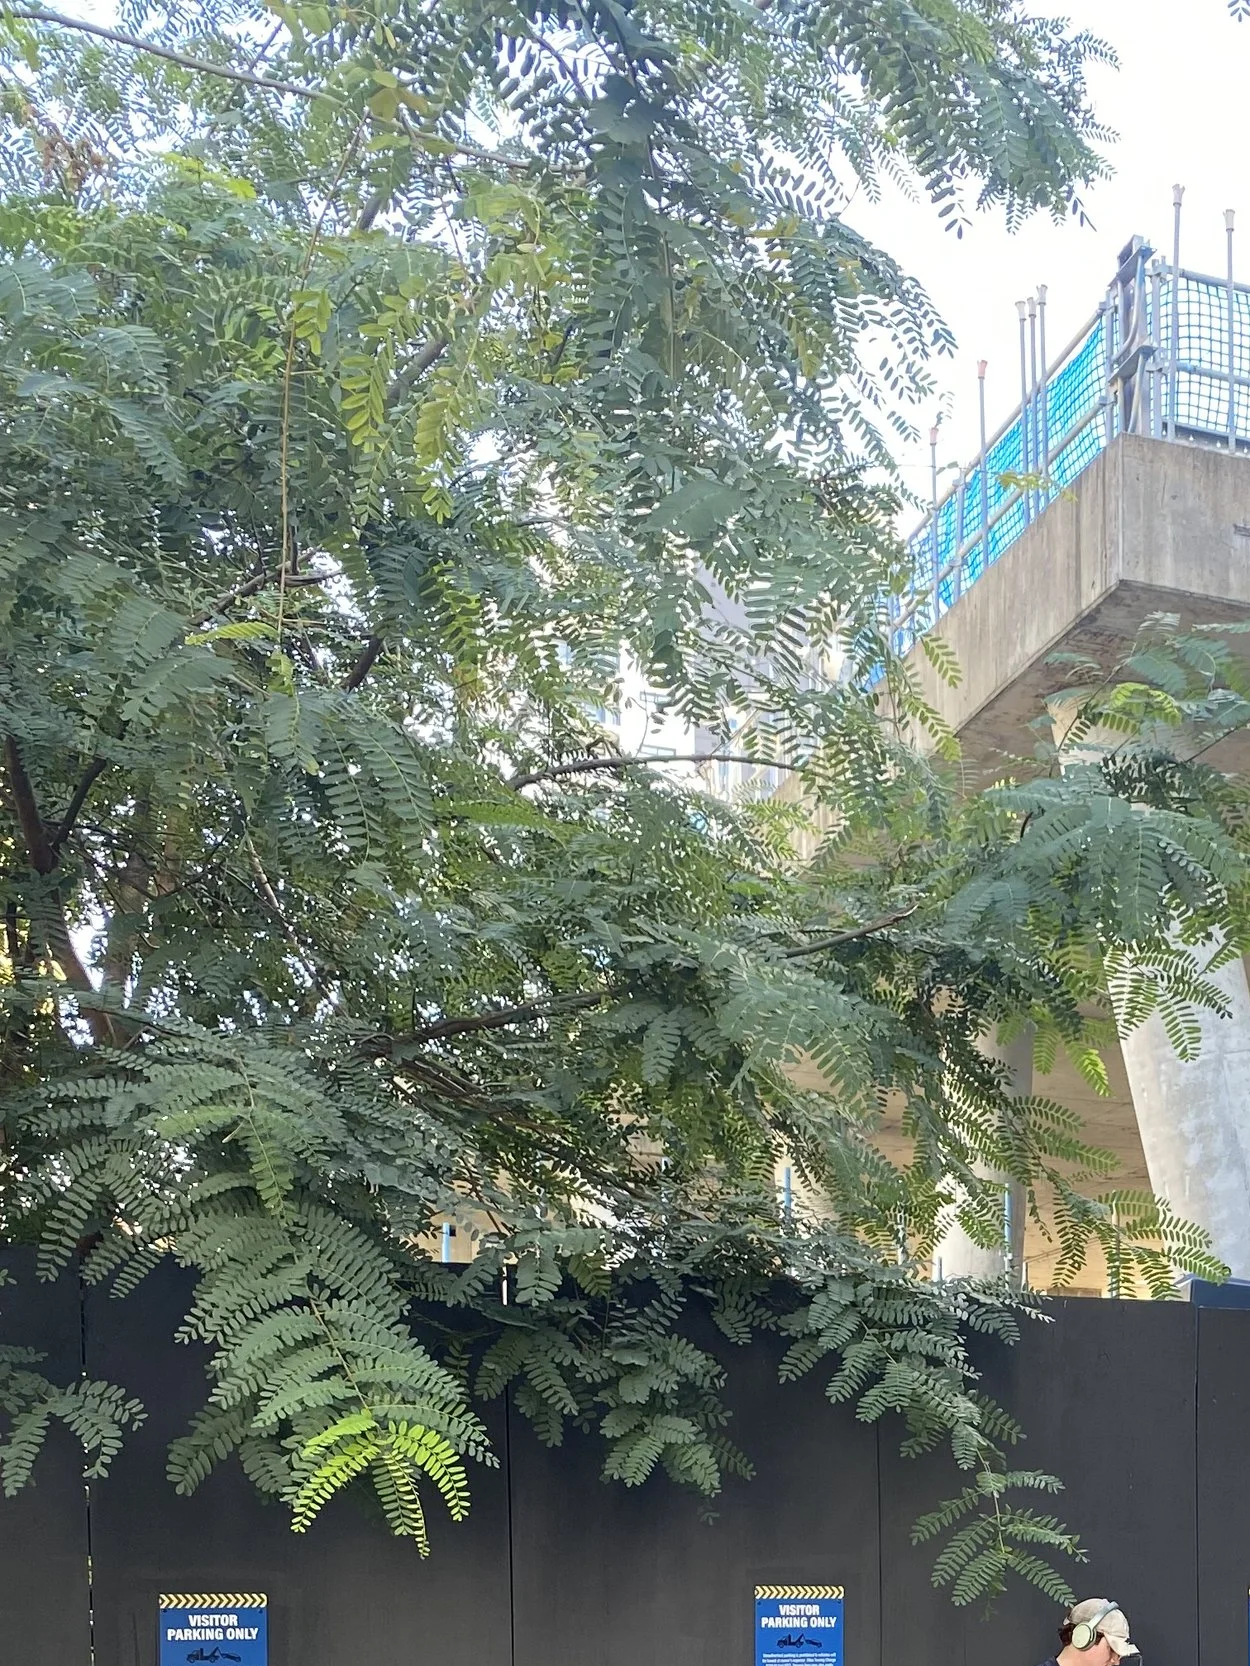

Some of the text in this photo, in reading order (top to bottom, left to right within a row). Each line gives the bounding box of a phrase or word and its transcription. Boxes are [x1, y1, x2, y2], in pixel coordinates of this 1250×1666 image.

[779, 1604, 820, 1616] VISITOR
[188, 1614, 238, 1627] VISITOR
[761, 1617, 837, 1628] PARKING ONLY
[167, 1628, 258, 1641] PARKING ONLY
